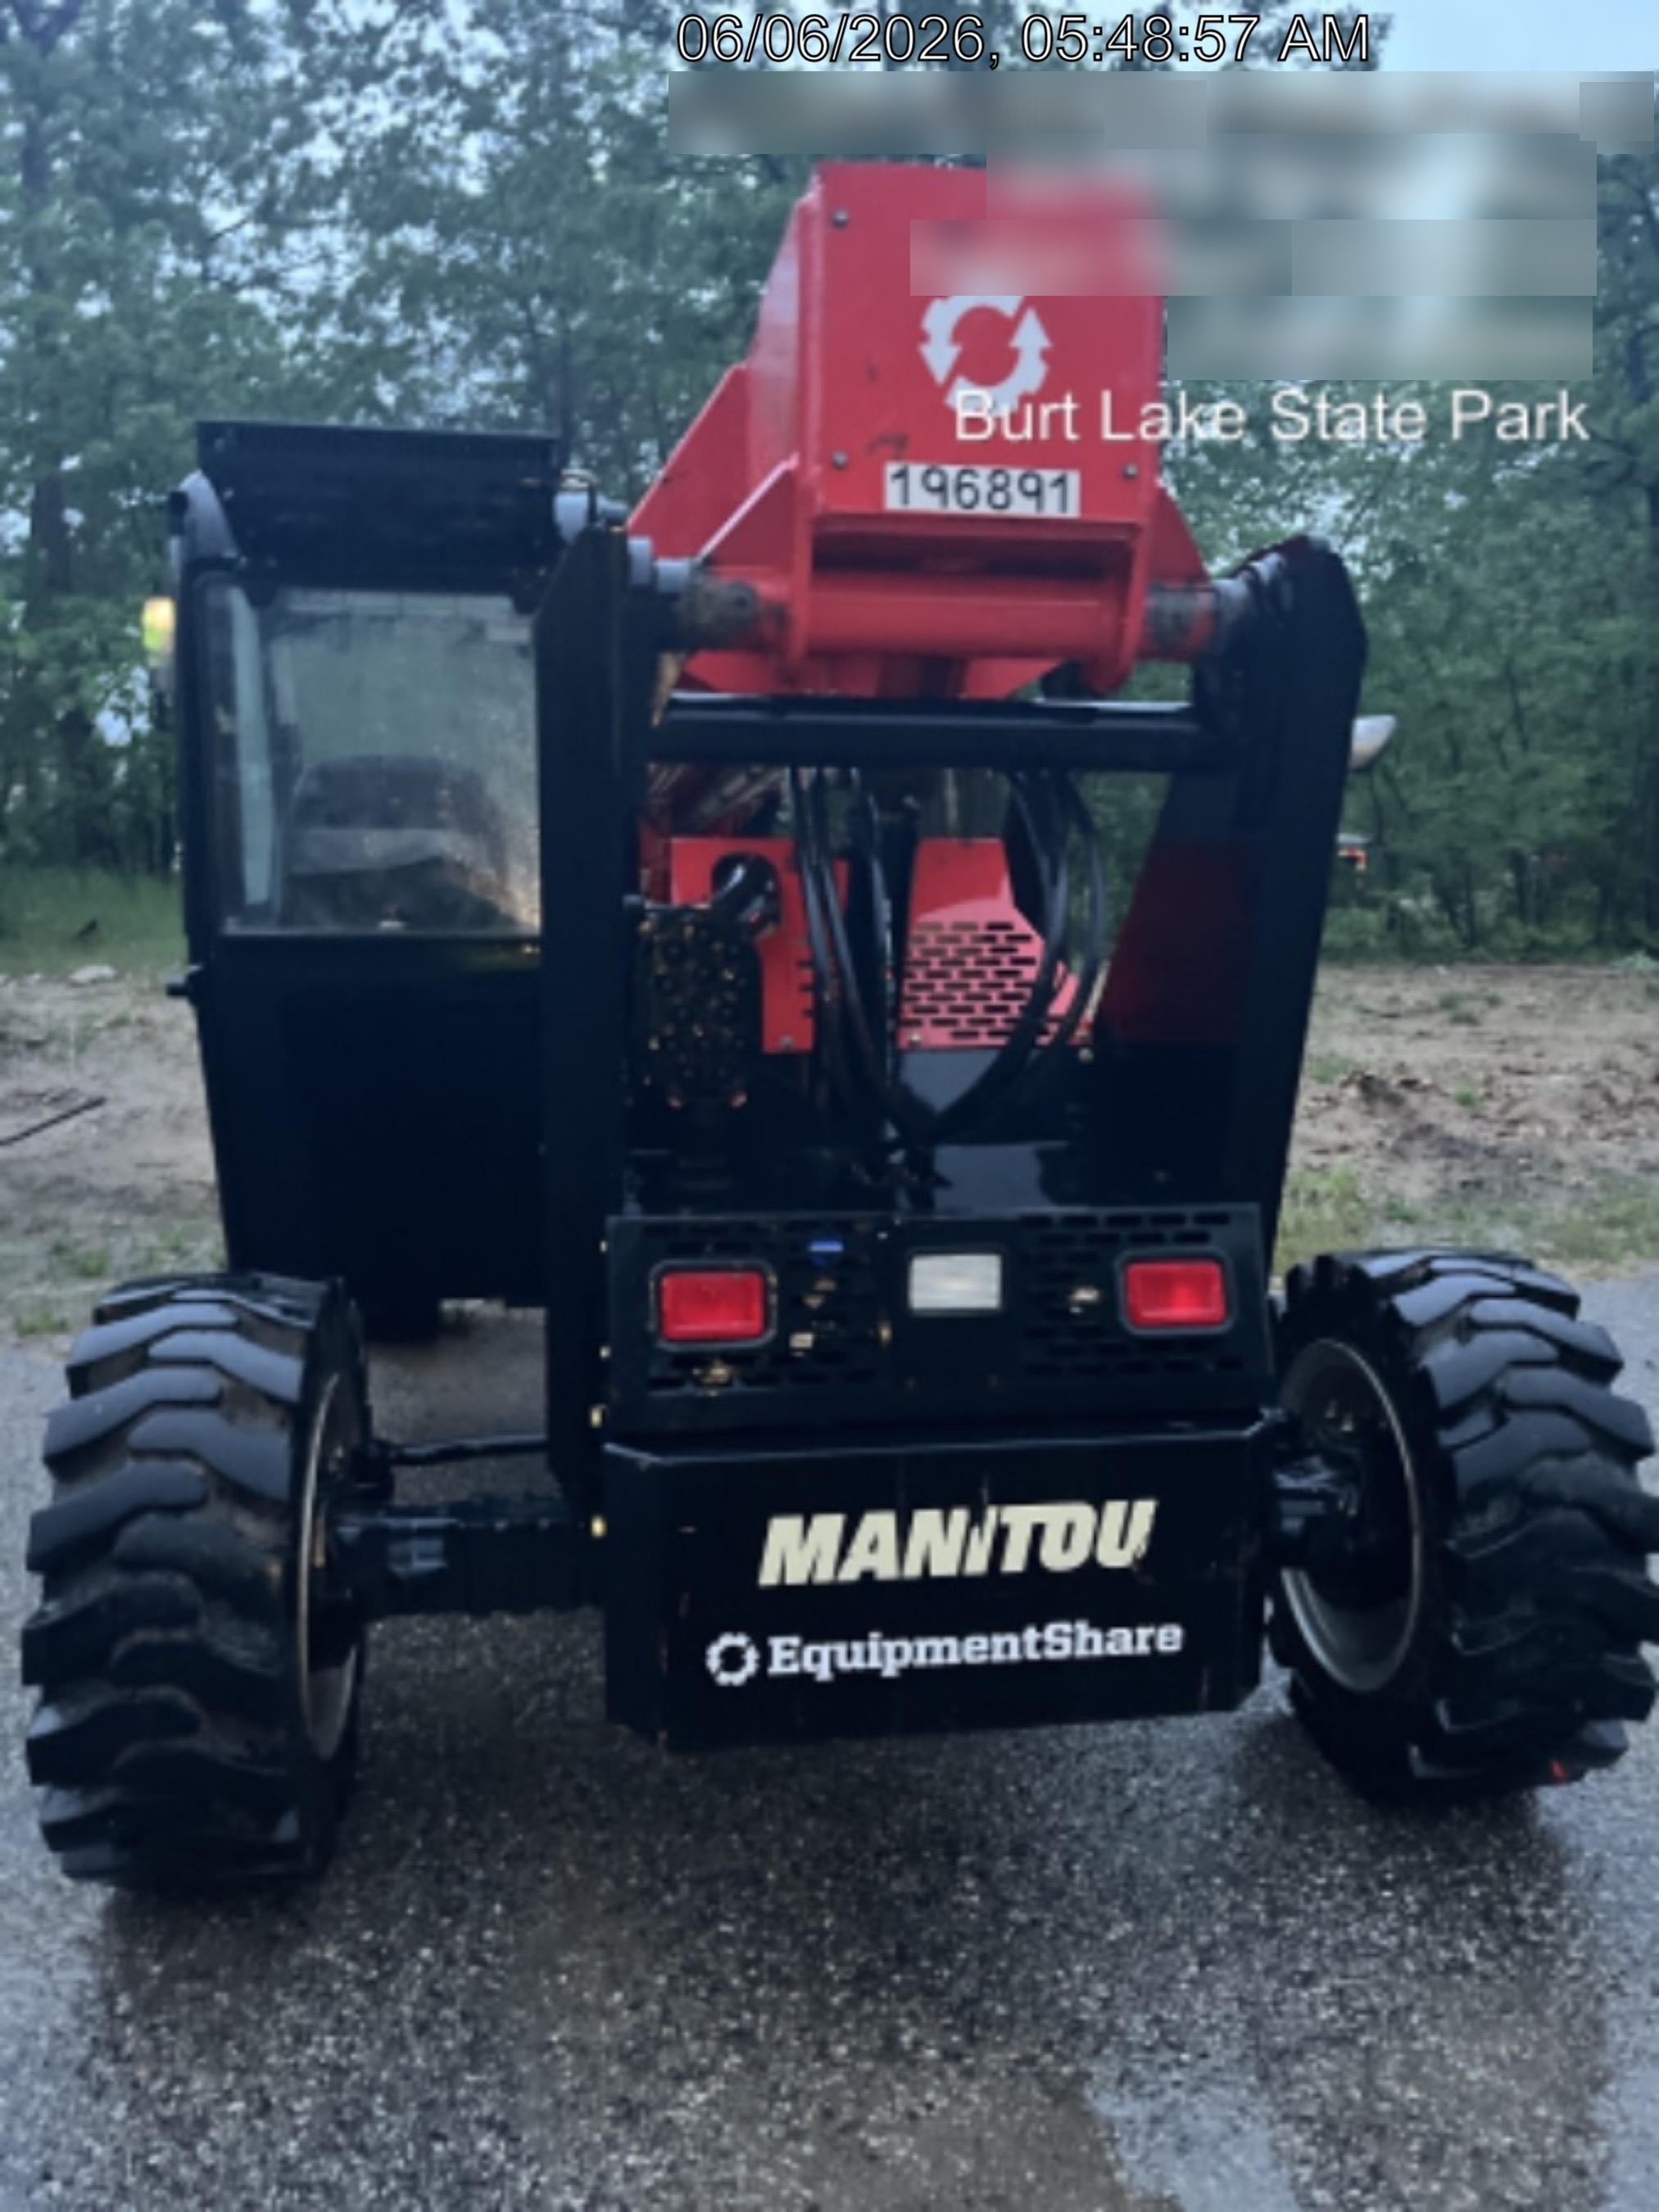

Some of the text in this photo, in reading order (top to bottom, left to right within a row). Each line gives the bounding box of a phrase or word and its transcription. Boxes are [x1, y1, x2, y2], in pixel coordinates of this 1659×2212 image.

[890, 465, 1070, 514] 196891
[758, 1499, 1158, 1586] MANITOU
[767, 1620, 1183, 1680] EquipmentShare
